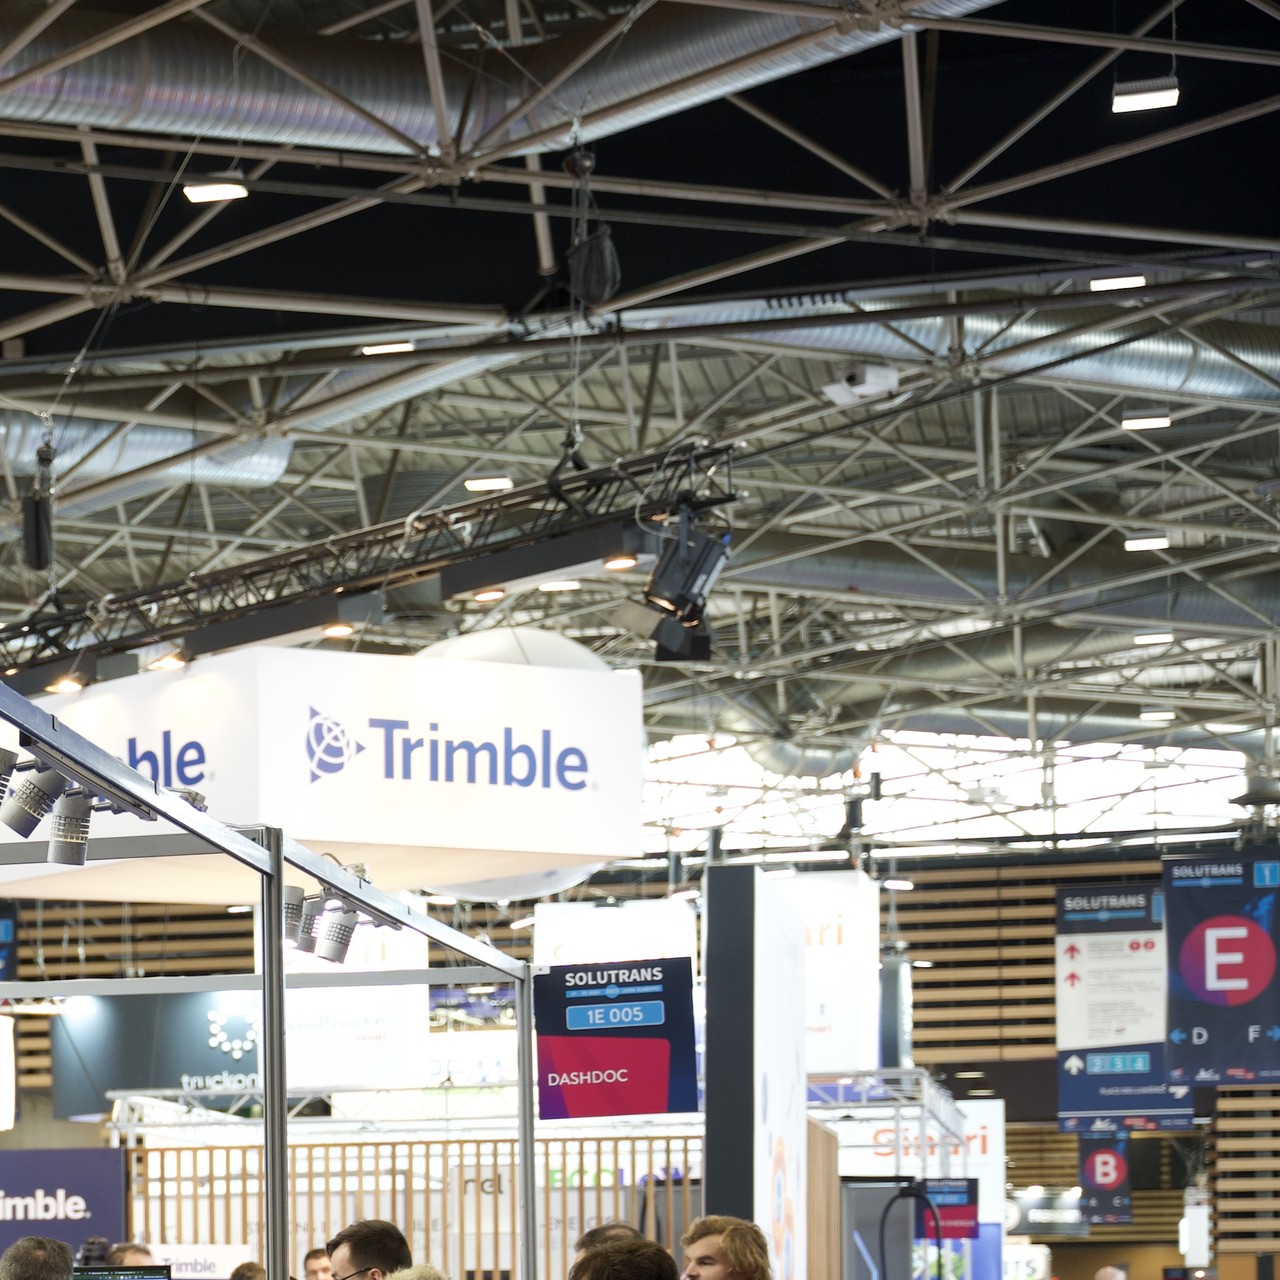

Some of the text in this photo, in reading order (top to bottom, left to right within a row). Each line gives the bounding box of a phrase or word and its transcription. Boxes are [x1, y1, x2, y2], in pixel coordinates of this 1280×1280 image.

[369, 717, 590, 792] Trimble
[1172, 864, 1243, 877] SOLUTRANS
[1064, 894, 1146, 910] SOLUTRANS
[1205, 926, 1248, 991] E
[565, 967, 663, 986] SOLUTRANS
[587, 1007, 643, 1024] 1E 005
[1192, 1025, 1260, 1044] D F
[1114, 1057, 1122, 1071] 3
[1134, 1057, 1143, 1070] 4
[547, 1069, 628, 1086] DASHDOC
[1095, 1153, 1117, 1184] B
[161, 1258, 217, 1273] Trimble
